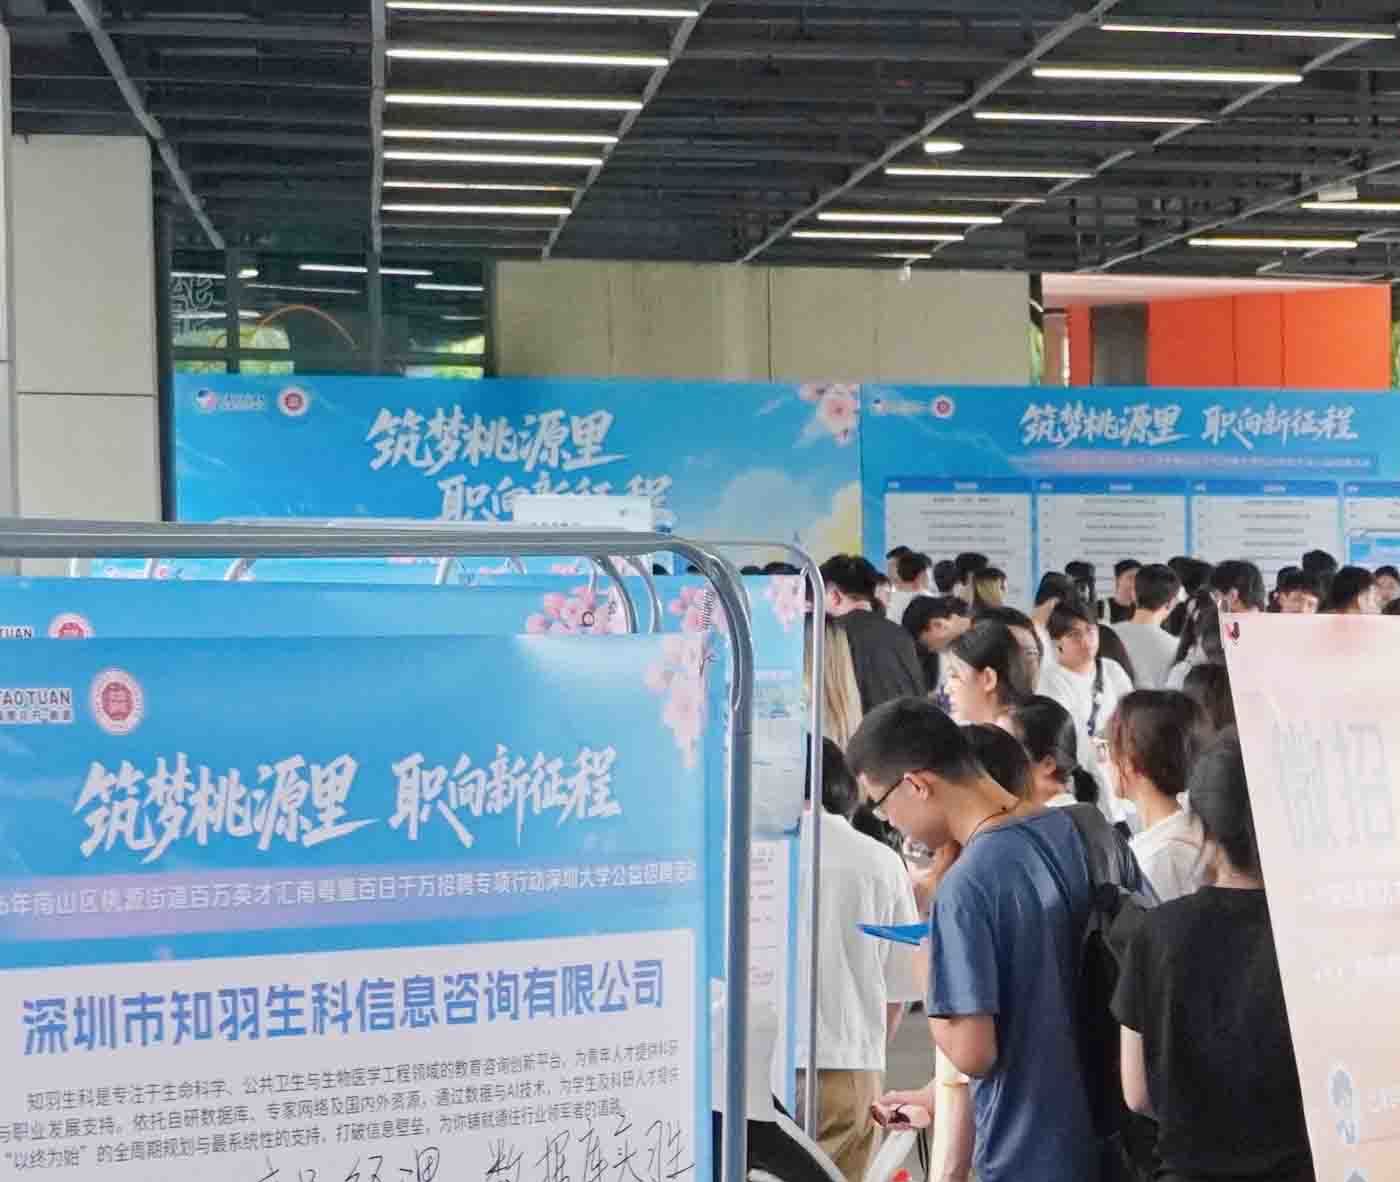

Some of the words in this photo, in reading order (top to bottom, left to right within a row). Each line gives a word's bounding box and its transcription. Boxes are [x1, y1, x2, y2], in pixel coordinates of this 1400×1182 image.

[364, 405, 630, 473] 筑梦桃源里
[1019, 401, 1189, 450] 筑梦桃源里
[1201, 401, 1360, 450] 职向新征程
[72, 751, 379, 864] 筑梦桃源里
[389, 745, 623, 848] 职向新征程
[22, 959, 664, 1056] 深圳市知羽生科信息咨询有限公司
